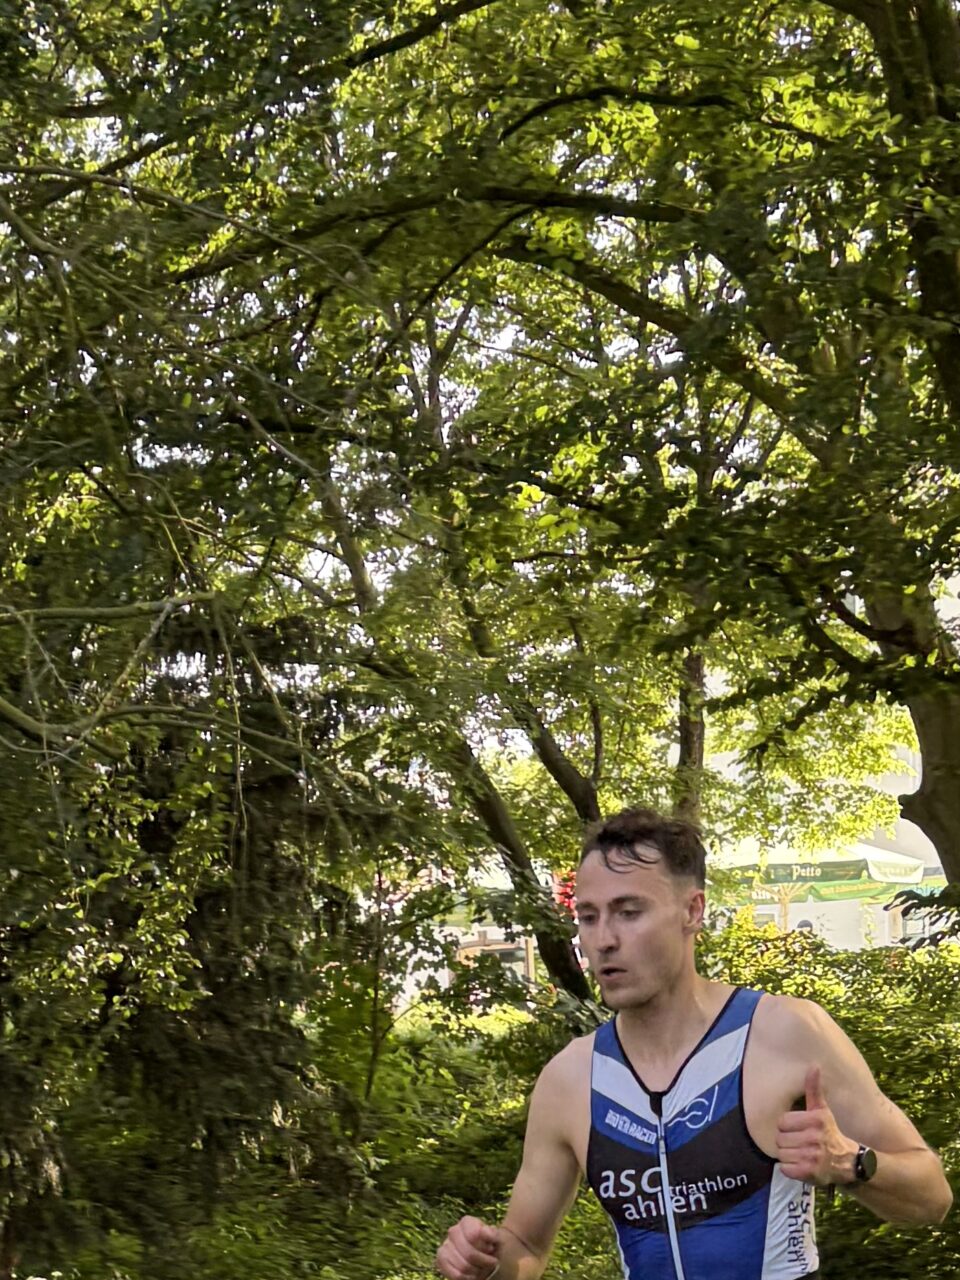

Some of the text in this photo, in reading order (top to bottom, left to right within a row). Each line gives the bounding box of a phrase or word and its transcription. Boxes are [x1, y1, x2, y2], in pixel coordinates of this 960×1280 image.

[599, 1166, 748, 1199] asc triathlon
[622, 1191, 708, 1220] ahlen
[787, 1200, 803, 1262] ahlen
